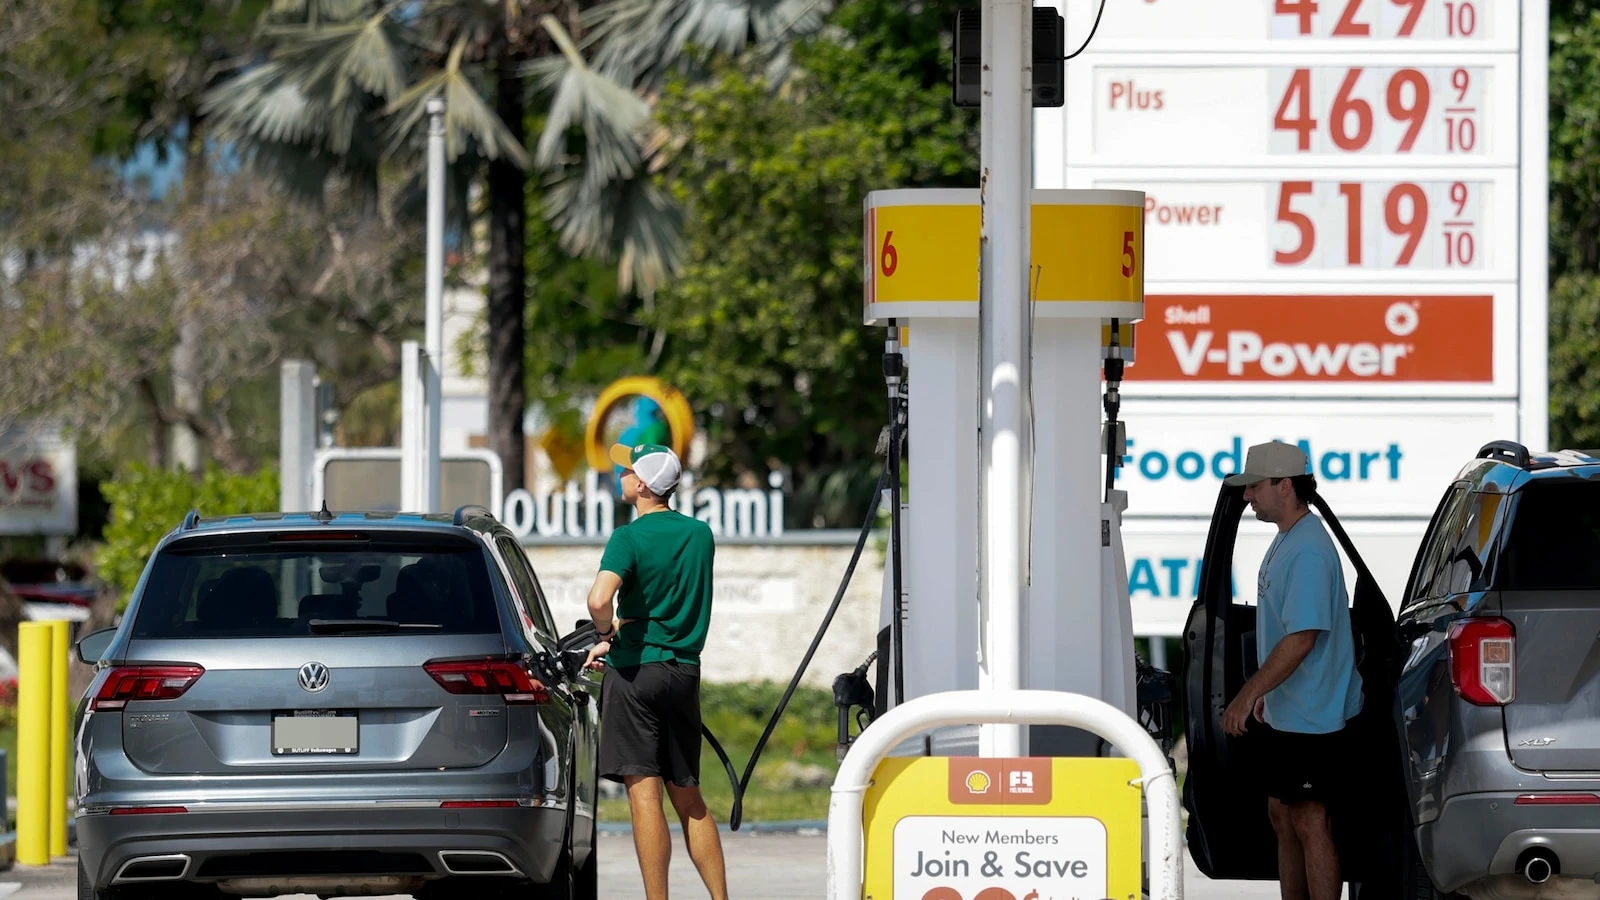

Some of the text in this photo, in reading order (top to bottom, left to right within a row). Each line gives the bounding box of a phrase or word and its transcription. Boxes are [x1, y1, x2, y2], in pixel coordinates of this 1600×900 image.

[1274, 0, 1476, 37] 42 10
[1109, 67, 1476, 152] Plus 469 9 10
[1450, 181, 1468, 216] 9
[1273, 181, 1429, 266] 519
[881, 231, 898, 277] 6
[1121, 231, 1136, 278] 5
[1443, 232, 1475, 265] 10
[1164, 305, 1211, 325] Shell
[1166, 330, 1407, 376] V-Power
[503, 468, 784, 538] outh iami
[1518, 737, 1556, 747] XLT
[942, 829, 1059, 844] New Members
[910, 850, 1088, 878] Join & Save
